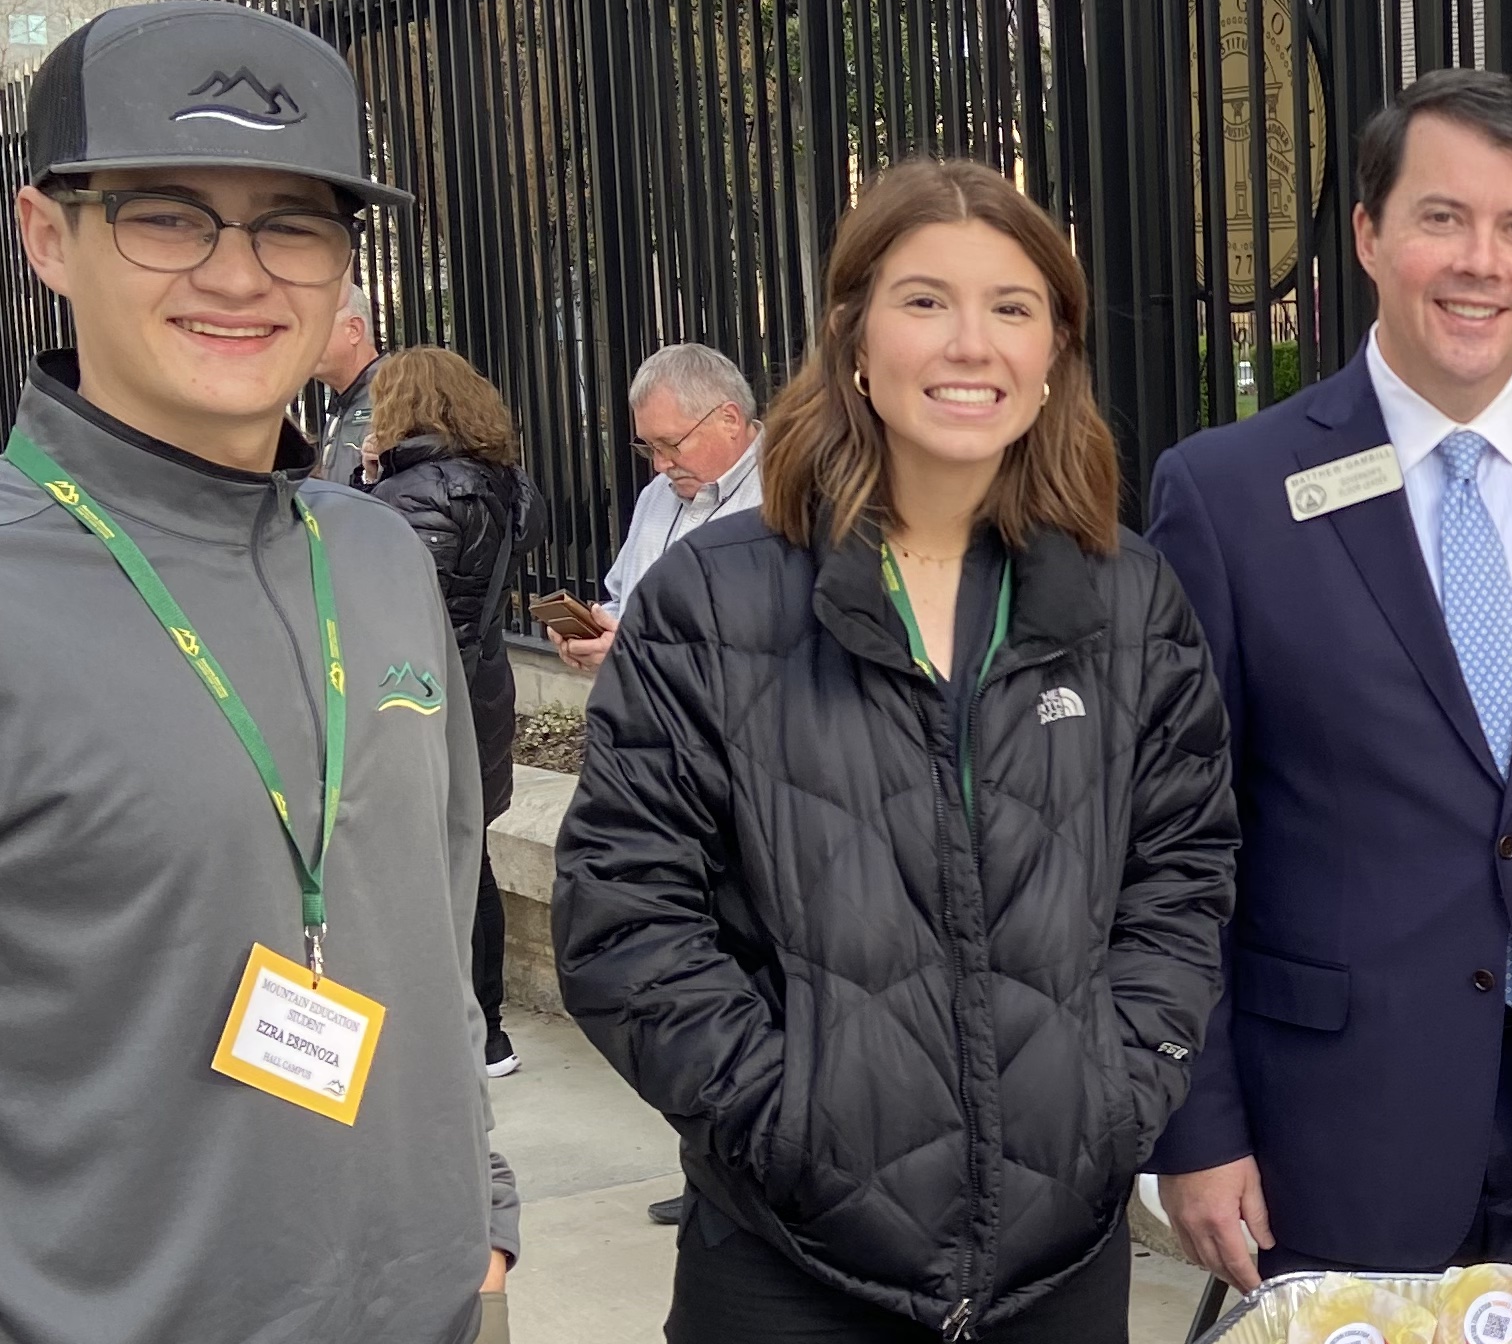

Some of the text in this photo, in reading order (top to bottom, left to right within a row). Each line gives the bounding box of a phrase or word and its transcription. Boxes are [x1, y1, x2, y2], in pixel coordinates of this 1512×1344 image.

[262, 978, 361, 1033] MOUNTAIN EDUCATION
[256, 1019, 340, 1068] EZRA ESPINOZA
